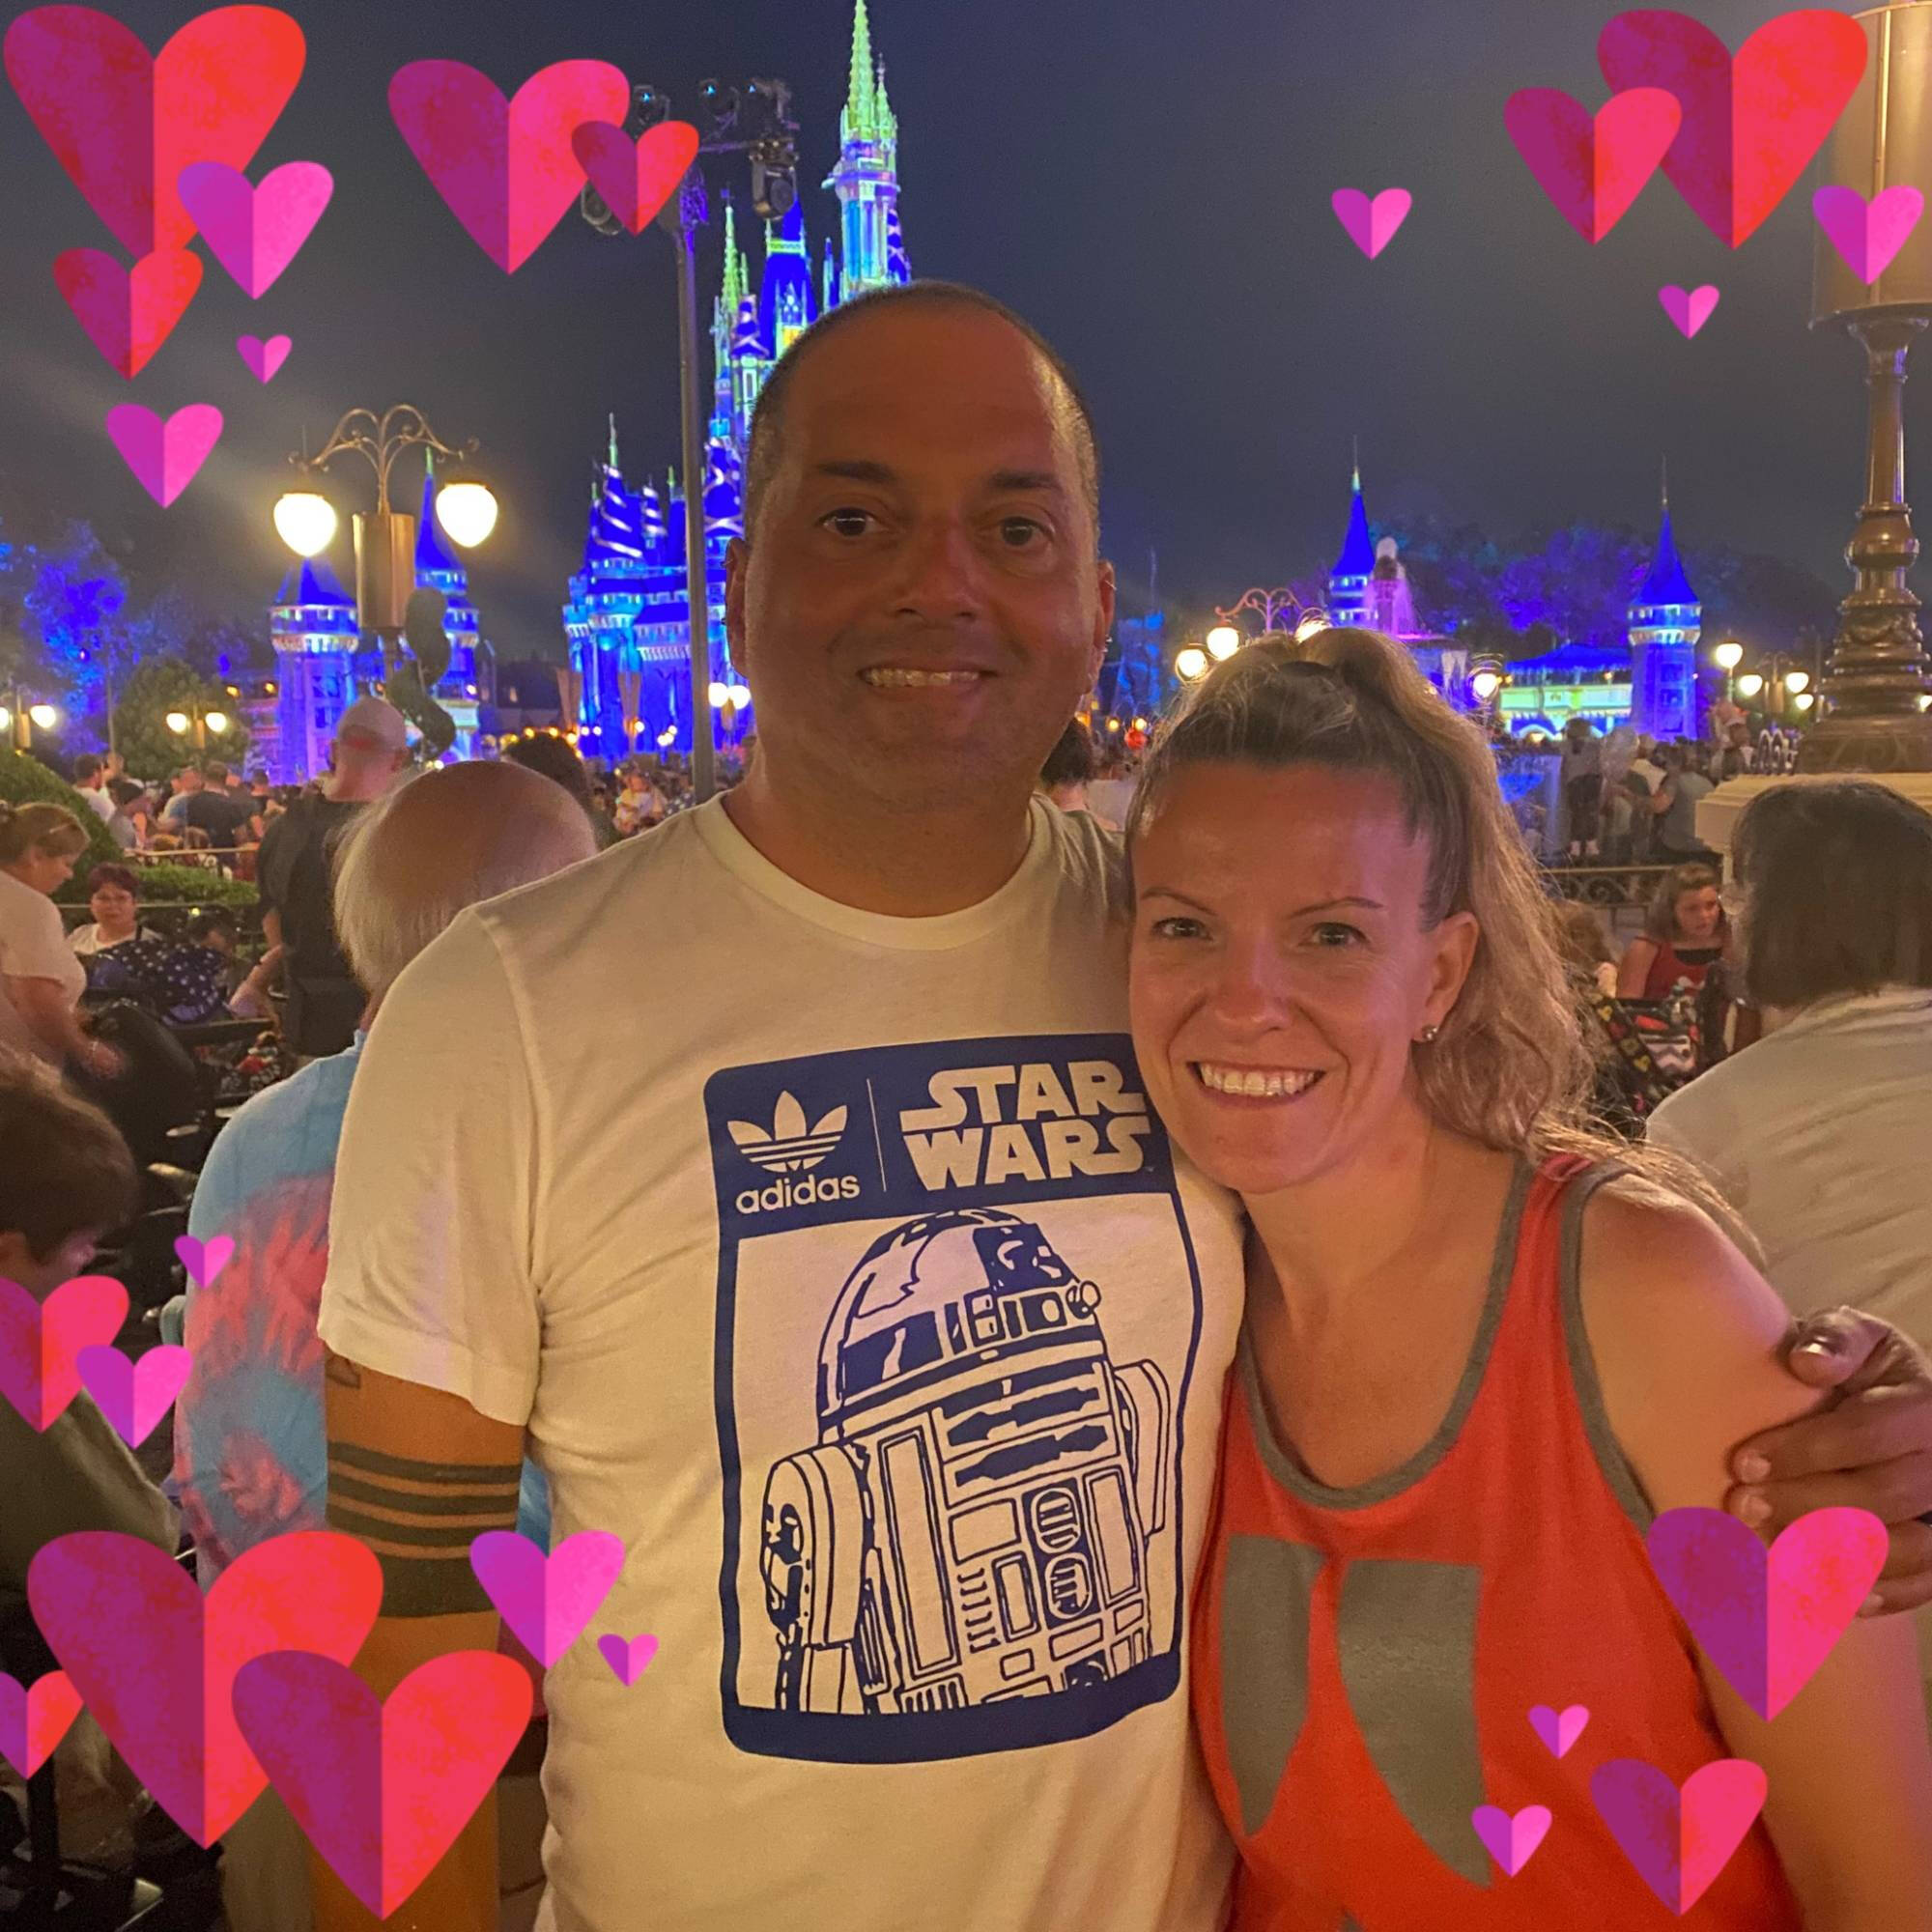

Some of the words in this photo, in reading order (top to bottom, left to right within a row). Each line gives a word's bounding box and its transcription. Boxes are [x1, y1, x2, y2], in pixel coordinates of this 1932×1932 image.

[899, 1061, 1147, 1132] STAR
[903, 1116, 1151, 1191] WARS
[736, 1174, 860, 1214] adidas
